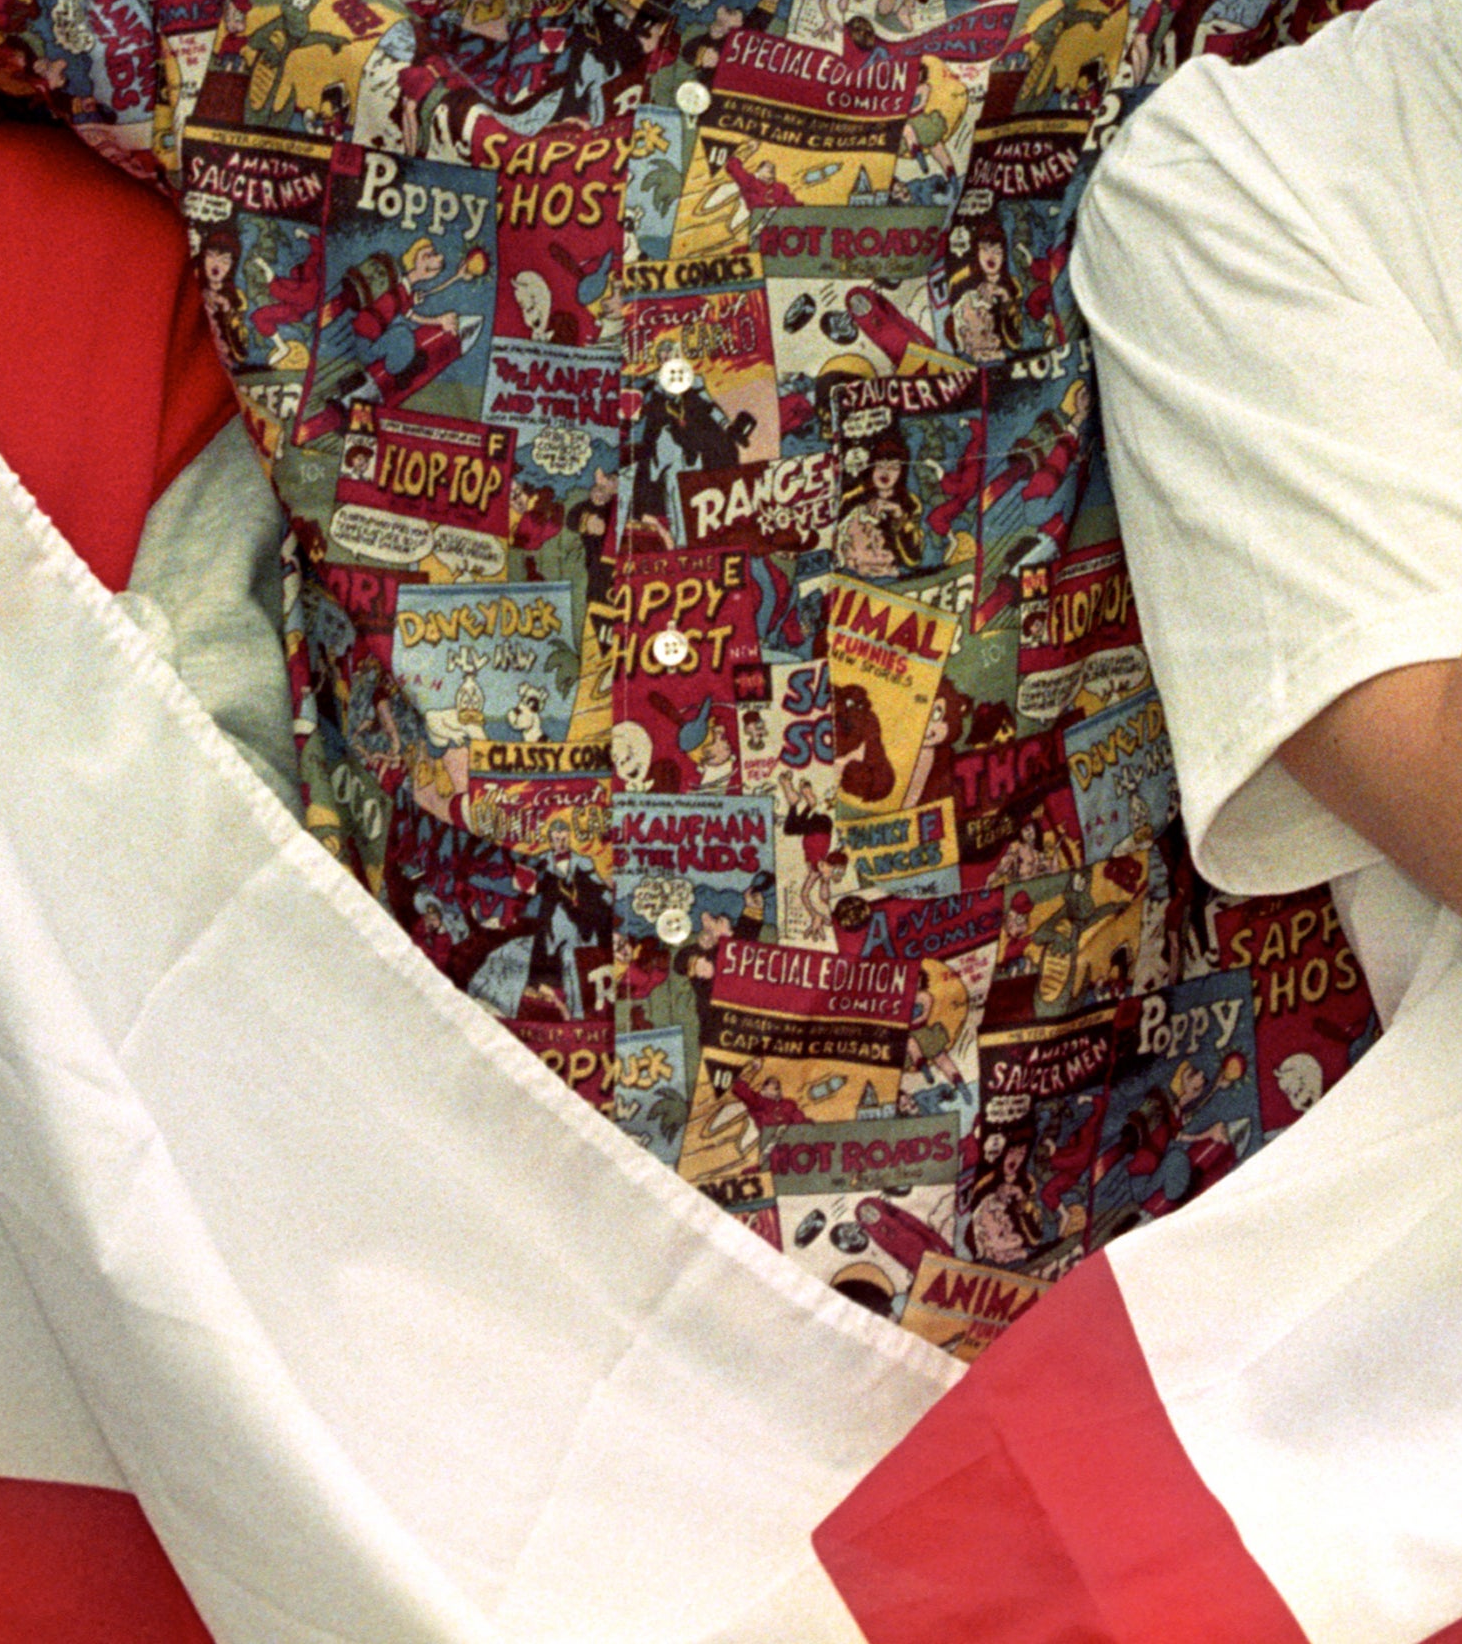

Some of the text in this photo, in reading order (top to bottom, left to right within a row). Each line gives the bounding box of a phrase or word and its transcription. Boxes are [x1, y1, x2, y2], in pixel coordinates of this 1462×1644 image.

[726, 30, 812, 81] SPECIAL
[826, 89, 904, 113] COMICS
[717, 114, 887, 149] CAPTAIN CRUSADE
[479, 132, 635, 176] SAPPY
[1031, 147, 1079, 190] MEN
[188, 157, 279, 211] SAUCER
[279, 170, 323, 208] MEN
[357, 152, 490, 240] Poppy
[759, 225, 939, 260] HOT ROADS
[843, 380, 938, 411] SAUCER
[623, 811, 767, 846] KAUFMAN
[677, 844, 760, 875] KIDS
[721, 942, 908, 995] SPECIAL EDITION
[828, 996, 902, 1016] COMICS
[1137, 993, 1244, 1060] Poppy
[719, 1029, 891, 1062] CAPTAIN CRUSADE
[988, 1036, 1109, 1095] SAUCER MEN
[769, 1131, 954, 1176] HOT ROADS
